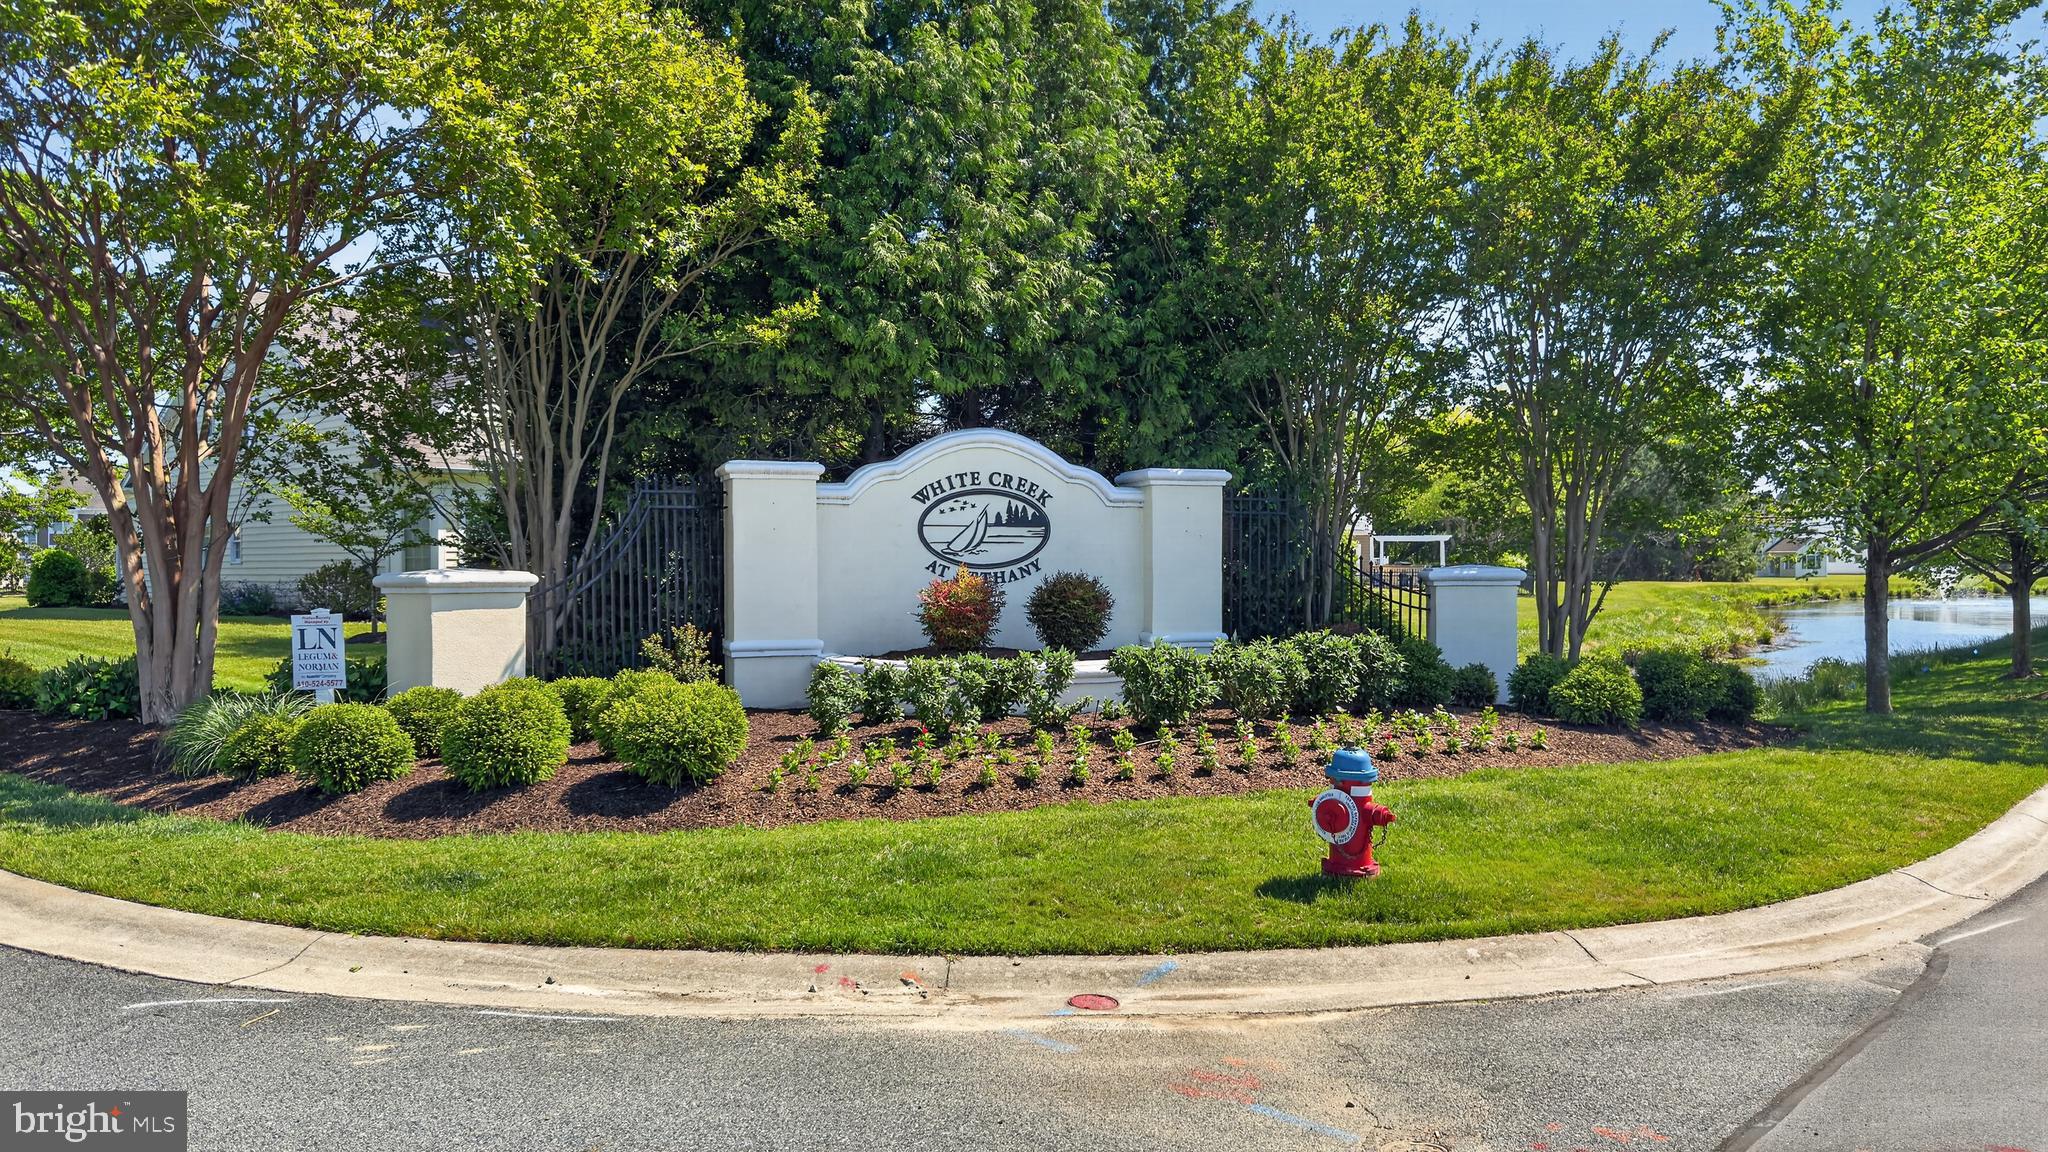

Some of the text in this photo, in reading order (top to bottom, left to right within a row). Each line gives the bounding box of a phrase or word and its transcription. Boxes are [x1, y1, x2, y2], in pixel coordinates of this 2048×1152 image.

[911, 471, 1053, 508] WHITE CREEK
[925, 557, 1042, 585] AT THANY
[297, 627, 337, 651] LN
[298, 663, 339, 672] NORMAN
